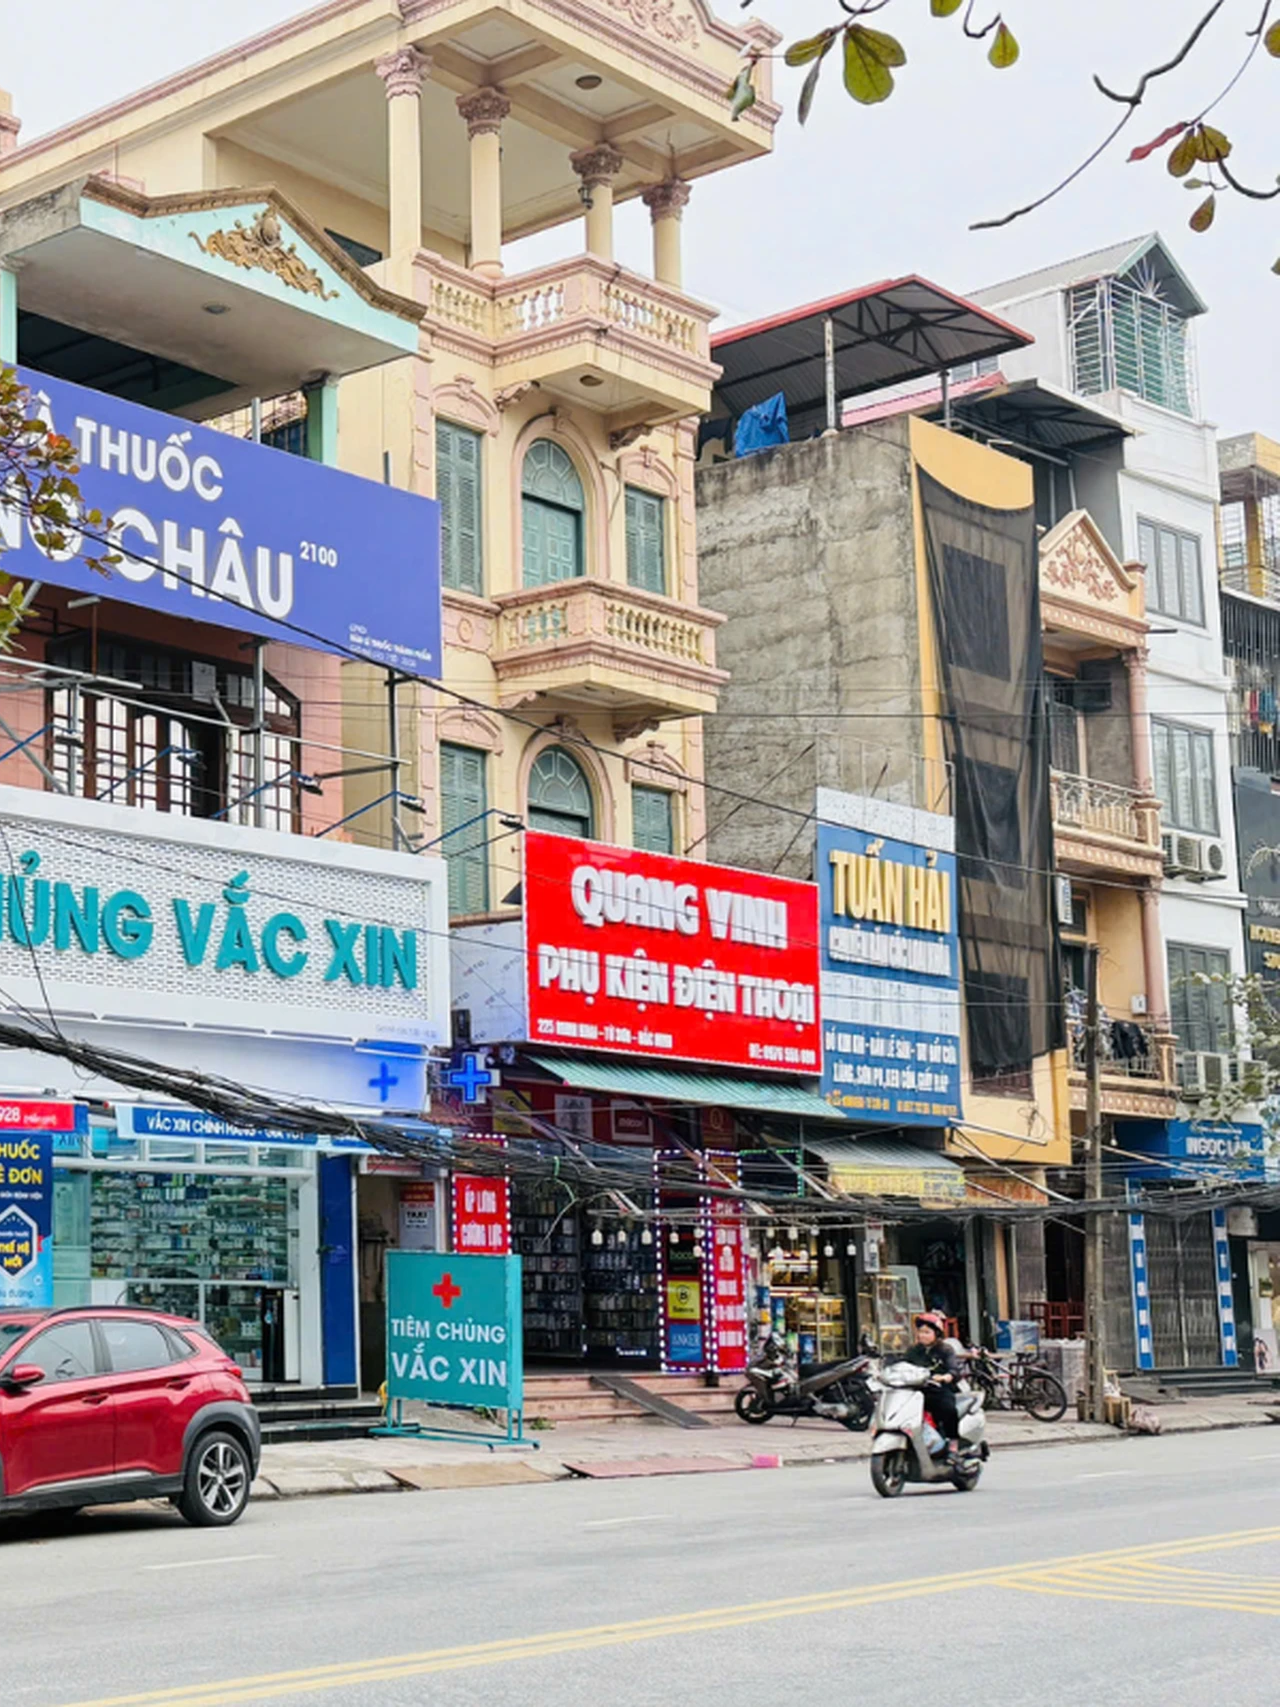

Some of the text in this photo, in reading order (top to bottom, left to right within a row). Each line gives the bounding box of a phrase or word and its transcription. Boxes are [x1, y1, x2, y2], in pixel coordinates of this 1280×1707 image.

[74, 416, 224, 501] THUỐC
[110, 507, 294, 619] CHÂU
[299, 540, 338, 568] 2100
[570, 864, 700, 936] QUANG
[705, 887, 789, 950] VINH
[829, 838, 905, 927] TUẤN
[171, 869, 309, 979] VẮC
[323, 918, 418, 992] XIN
[537, 943, 601, 1006] PHỤ
[605, 948, 670, 1013] KIỆN
[672, 958, 737, 1021] ĐIỆN
[738, 973, 816, 1033] THOẠI
[7, 1165, 44, 1185] ĐƠN
[391, 1314, 506, 1344] TIÊM CHỦNG
[391, 1343, 507, 1387] VẮC XIN
